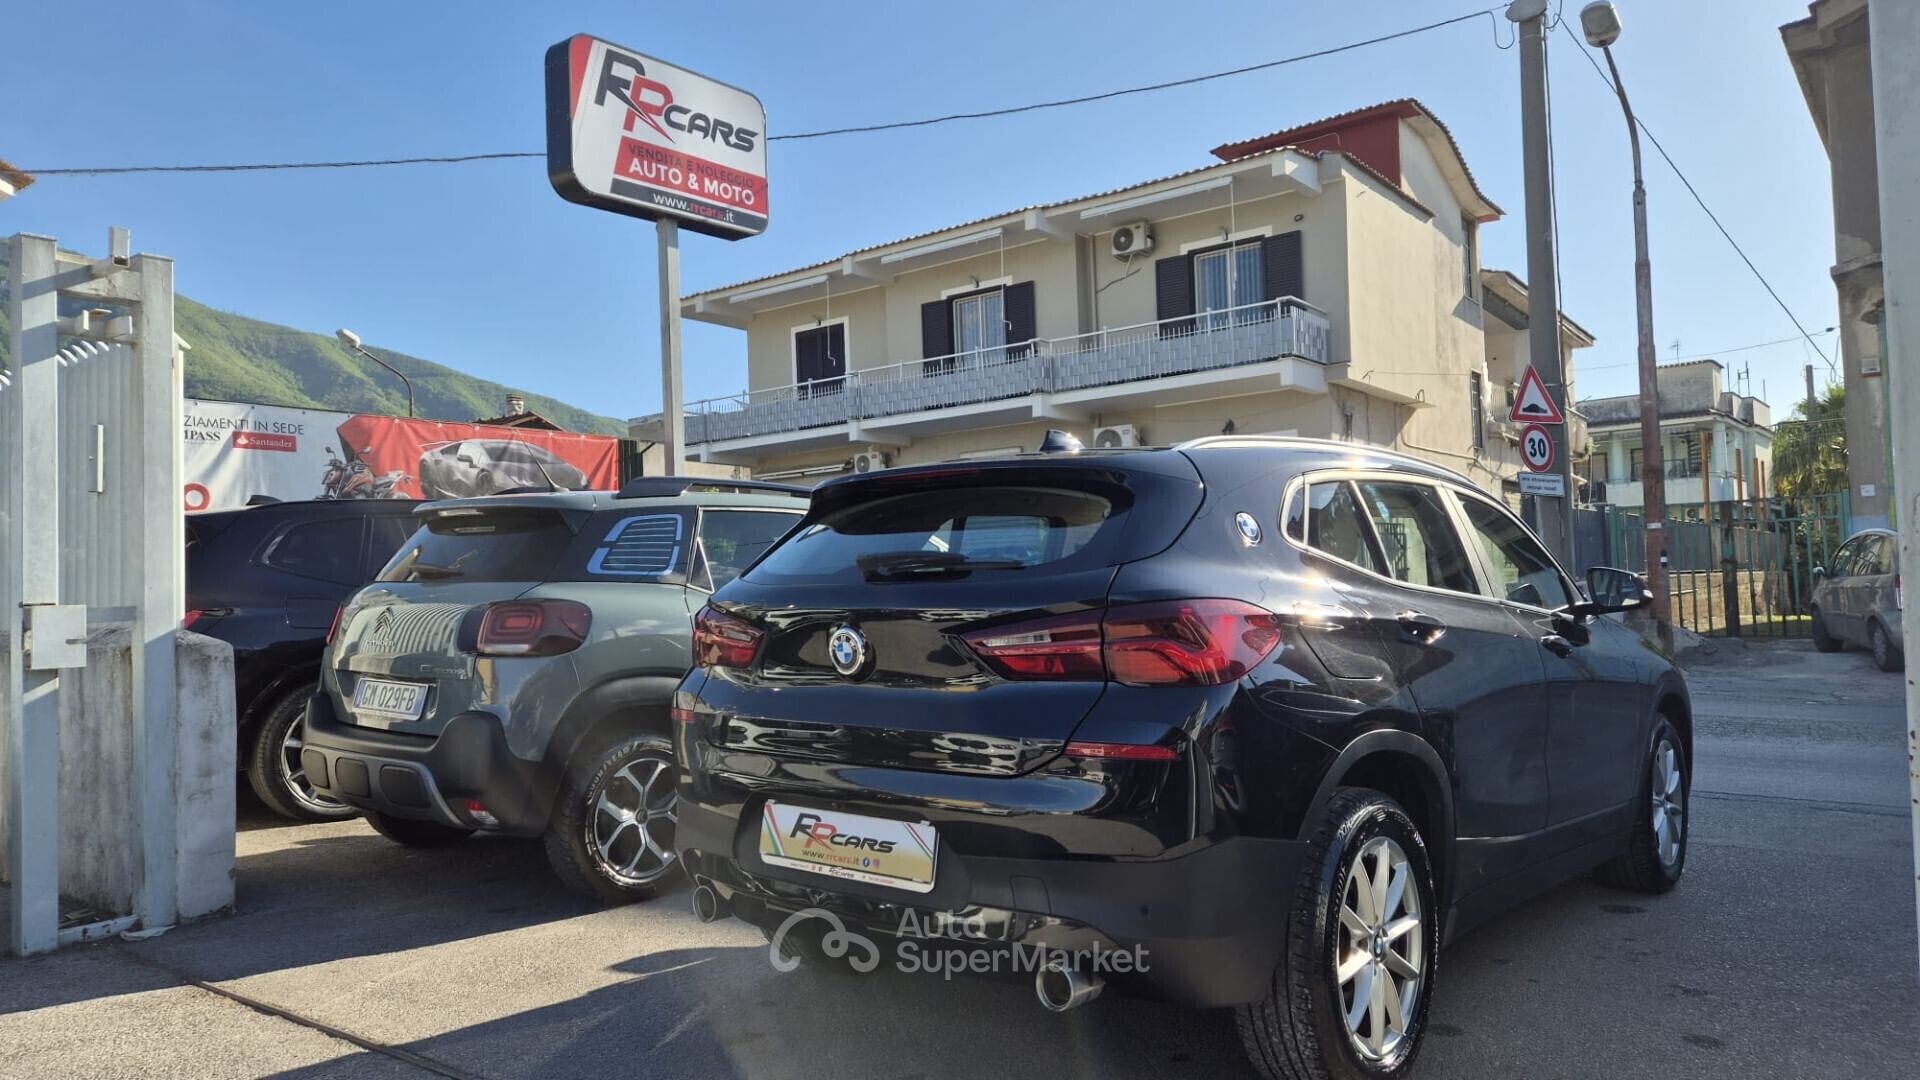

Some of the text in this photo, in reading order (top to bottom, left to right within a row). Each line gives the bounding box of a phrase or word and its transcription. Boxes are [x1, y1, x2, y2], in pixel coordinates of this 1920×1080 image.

[628, 143, 754, 188] VENDITA E NOLEGGIO
[629, 157, 755, 205] AUTO & MOTO
[652, 193, 735, 223] www.rrcars.it
[254, 419, 269, 432] IN
[273, 422, 305, 435] SEDE
[250, 437, 293, 448] Santander
[1527, 437, 1547, 458] 30
[379, 686, 417, 711] 029FB
[802, 849, 860, 866] www.rrcars.it
